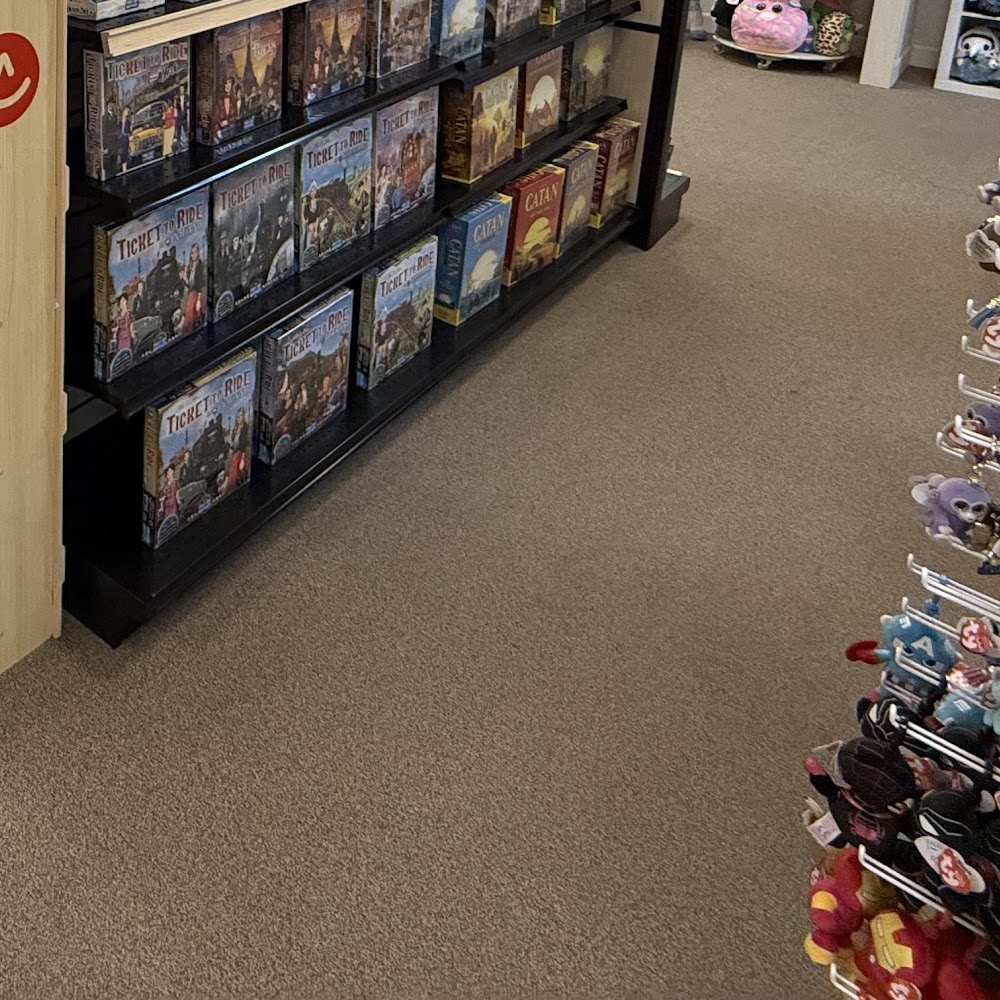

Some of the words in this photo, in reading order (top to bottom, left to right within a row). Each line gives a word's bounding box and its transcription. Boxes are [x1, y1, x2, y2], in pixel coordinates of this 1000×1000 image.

[105, 57, 147, 82] TICKET
[161, 44, 188, 66] RIDE
[382, 110, 410, 135] TICKET
[454, 107, 467, 145] CATAN
[306, 142, 340, 169] TICKET
[349, 127, 369, 149] RIDE
[220, 177, 257, 210] TICKET
[268, 161, 290, 184] RIDE
[525, 182, 559, 212] CATAN
[116, 223, 162, 261] TICKET
[163, 219, 175, 234] TO
[176, 204, 203, 229] RIDE
[473, 213, 505, 243] CATAN
[380, 268, 408, 298] TICKET
[416, 250, 434, 271] RIDE
[449, 238, 463, 277] CATAN
[283, 329, 316, 363] TICKET
[327, 307, 349, 331] RIDE
[166, 394, 210, 435] TICKET
[224, 370, 250, 398] RIDE
